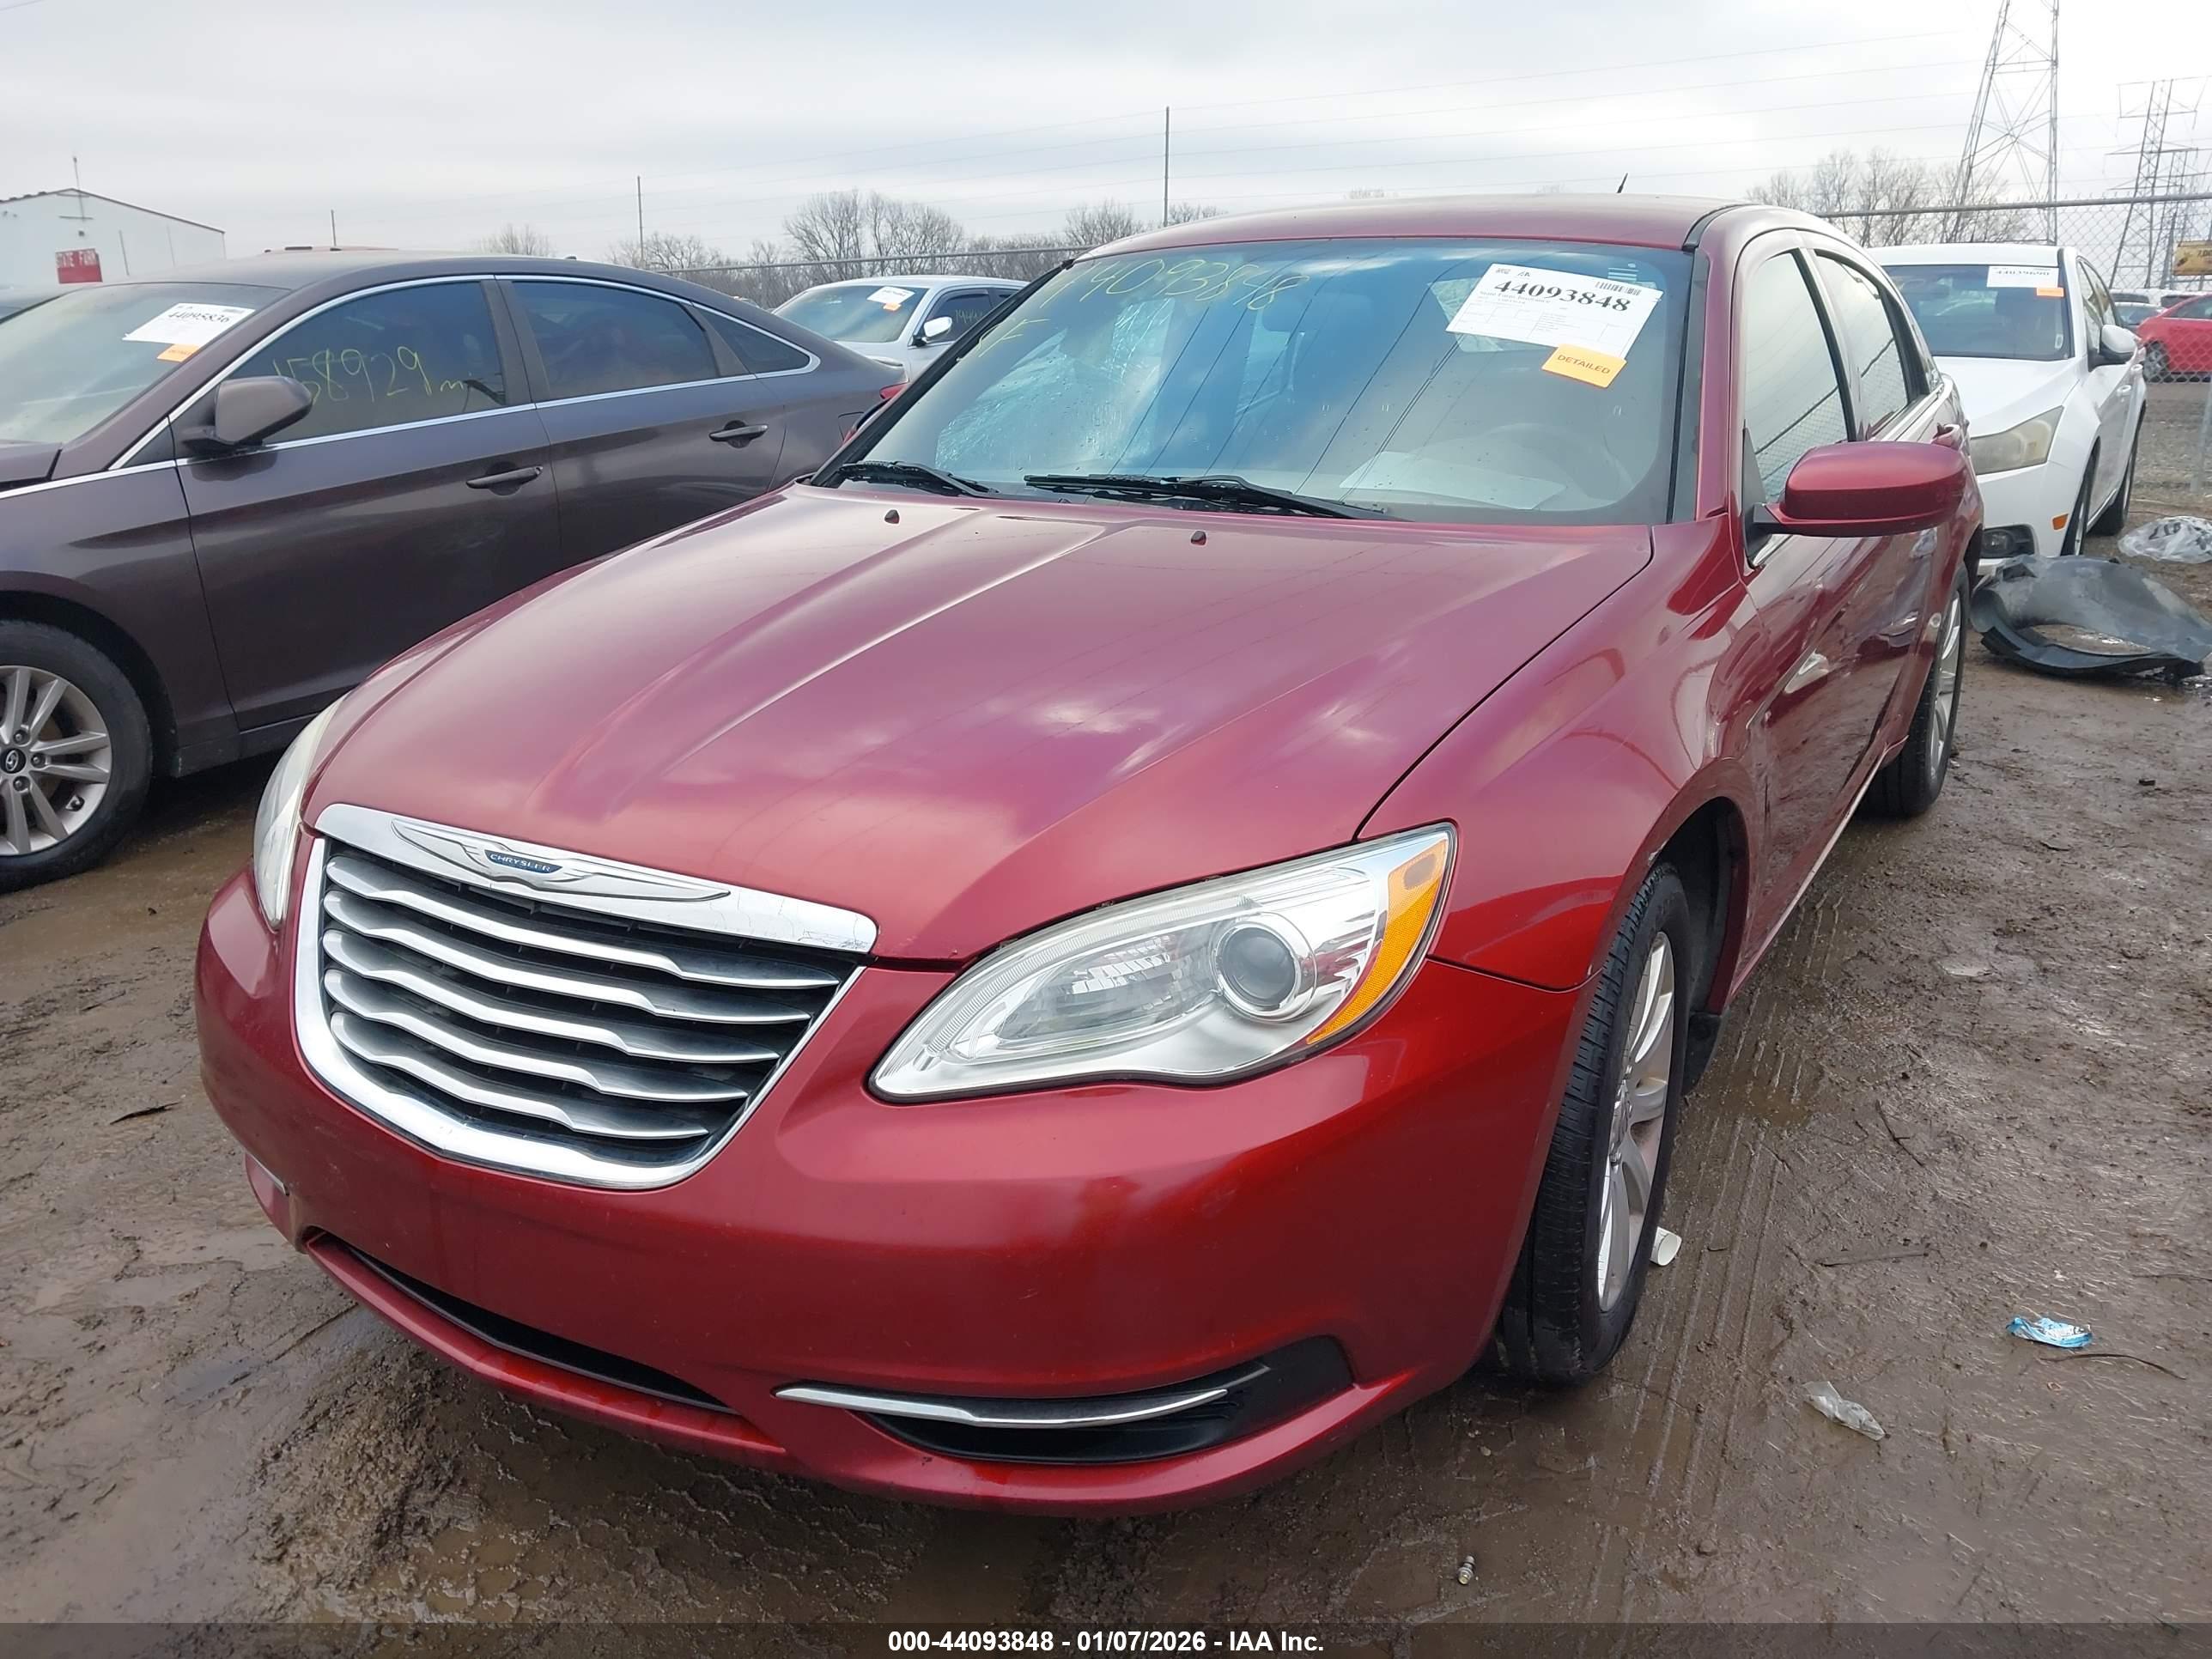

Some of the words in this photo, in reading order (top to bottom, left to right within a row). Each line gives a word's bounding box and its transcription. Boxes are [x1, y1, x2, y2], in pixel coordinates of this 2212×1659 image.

[1494, 280, 1632, 312] 44093848
[1557, 354, 1611, 374] DETAILED
[489, 854, 550, 872] CHRYSLER
